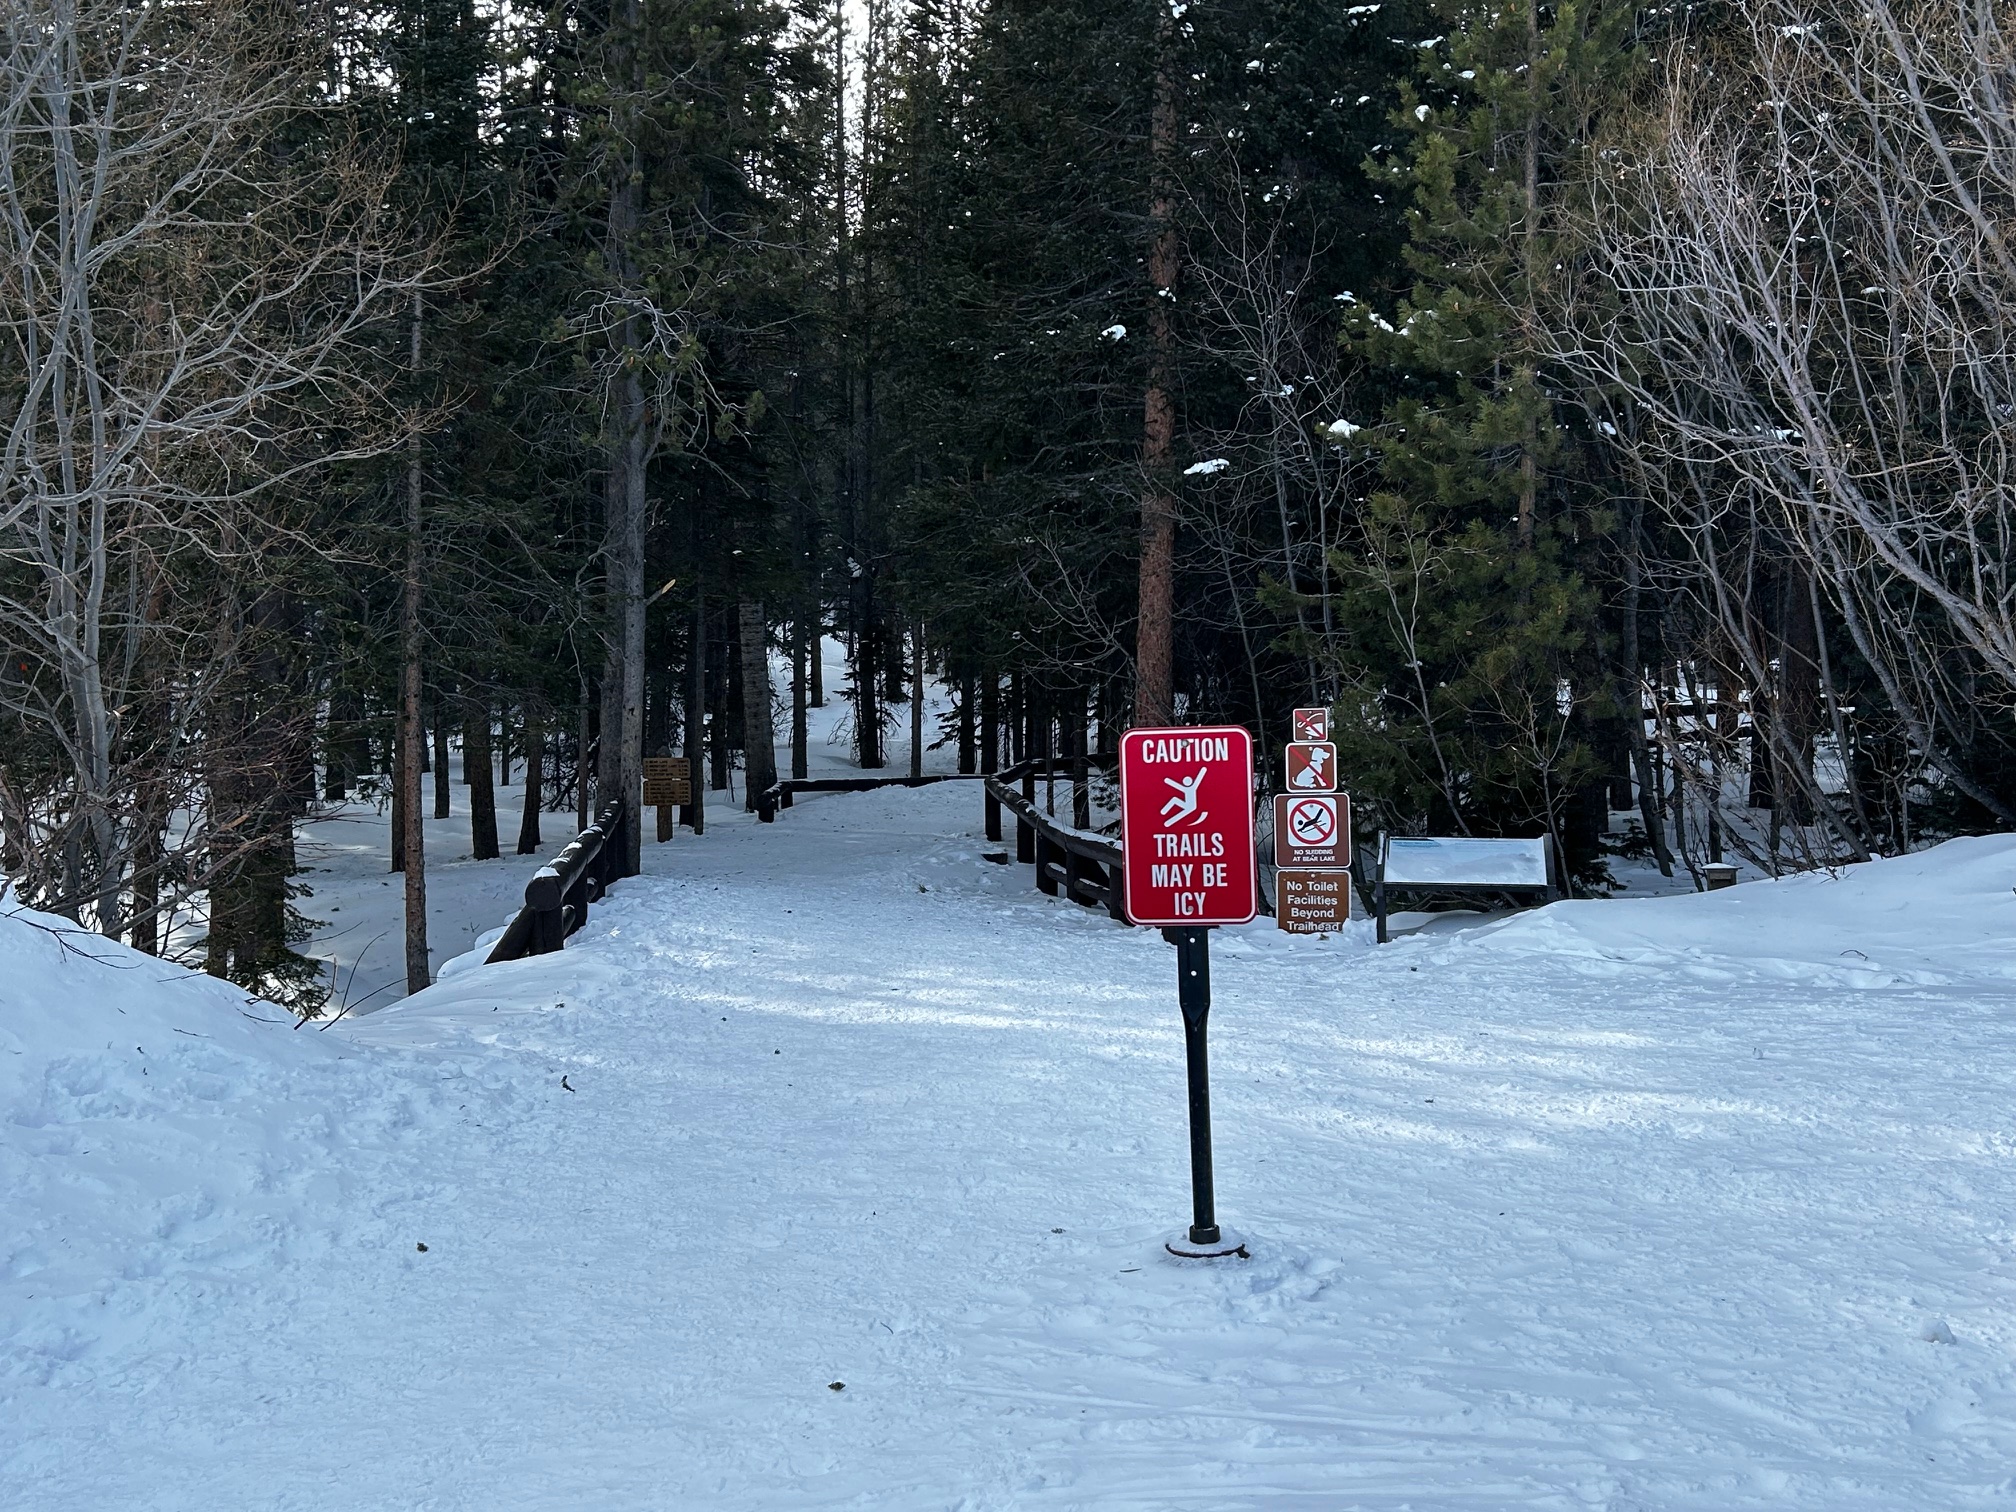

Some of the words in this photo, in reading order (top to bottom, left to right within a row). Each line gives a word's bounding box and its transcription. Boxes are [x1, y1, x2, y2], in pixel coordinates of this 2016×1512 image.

[1142, 737, 1229, 764] CAUTION
[1153, 832, 1224, 857] TRAILS
[1151, 863, 1194, 888] MAY
[1202, 863, 1228, 887] BE
[1286, 881, 1303, 891] No
[1306, 881, 1339, 891] Toilet
[1174, 892, 1206, 916] ICY
[1287, 894, 1338, 905] Facilities
[1291, 907, 1335, 919] Beyond
[1286, 921, 1339, 931] Trailhead
